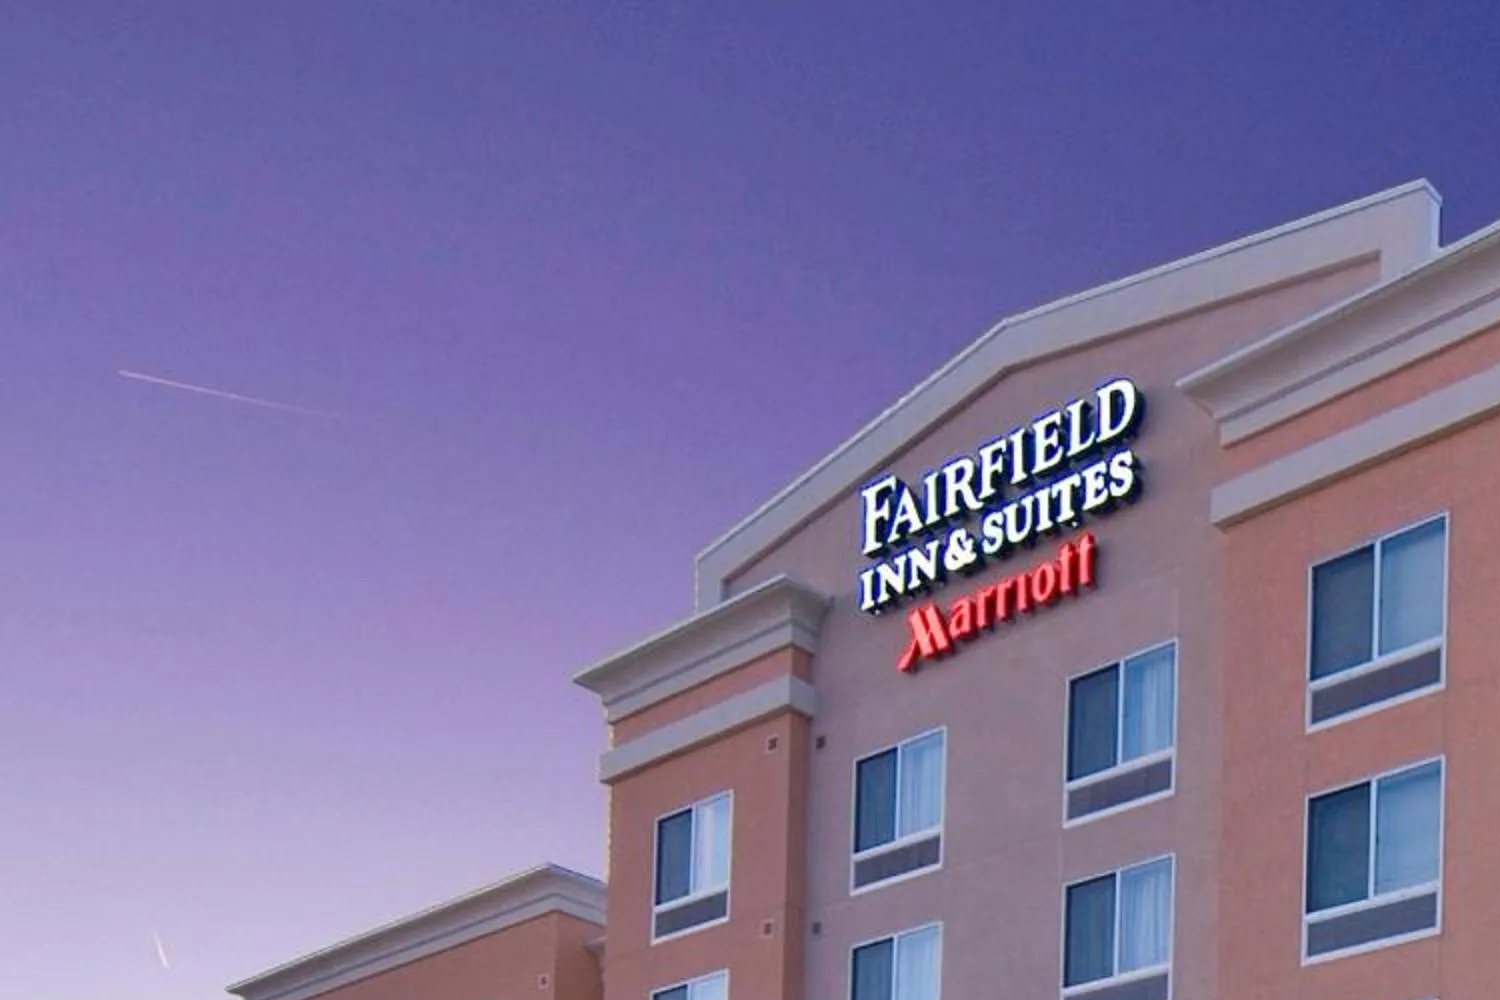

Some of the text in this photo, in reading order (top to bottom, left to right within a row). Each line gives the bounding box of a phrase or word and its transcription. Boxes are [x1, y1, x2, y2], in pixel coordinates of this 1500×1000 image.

[861, 377, 1137, 556] FAIRFIELD
[982, 450, 1134, 554] SUITES
[898, 530, 1095, 671] Marriott
